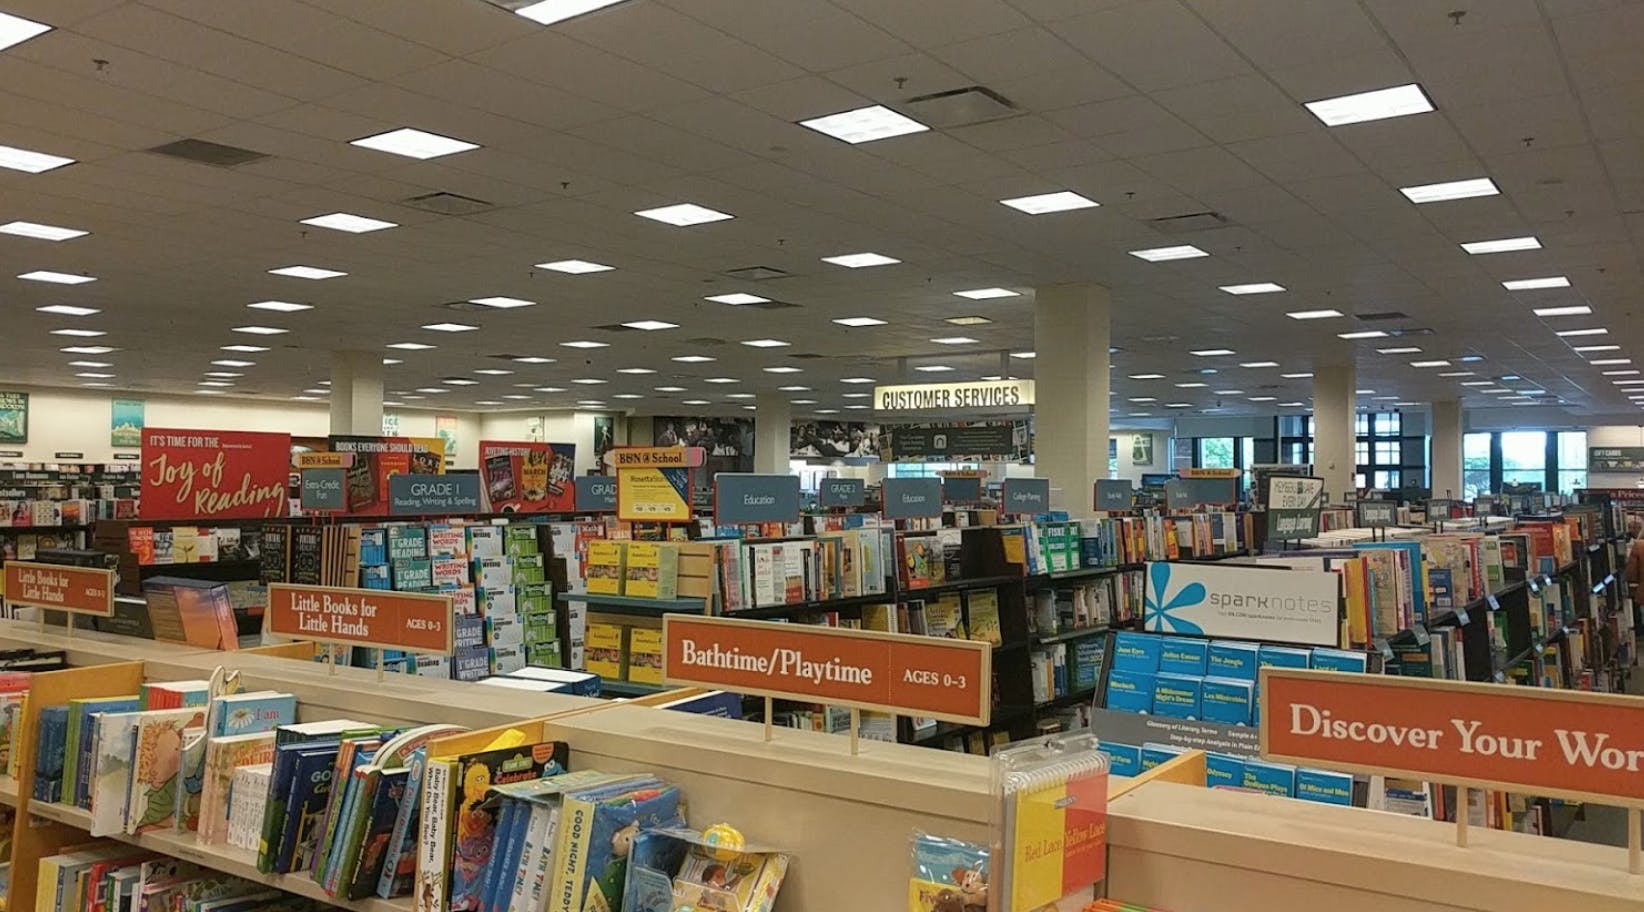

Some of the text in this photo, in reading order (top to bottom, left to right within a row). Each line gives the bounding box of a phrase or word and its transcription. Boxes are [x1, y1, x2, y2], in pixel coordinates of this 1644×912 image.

[883, 386, 1019, 410] CUSTOMER SERVICES
[150, 435, 165, 447] IT'S
[167, 436, 186, 447] TIME
[188, 436, 202, 448] FOR
[204, 437, 219, 448] THE
[335, 441, 357, 451] BOOKS
[390, 443, 412, 452] SHOULD
[652, 452, 682, 463] School
[150, 451, 226, 503] Joy of
[194, 472, 284, 518] Reading
[411, 484, 451, 495] GRADE
[394, 498, 420, 508] Reading,
[422, 496, 446, 507] Writing
[744, 494, 775, 505] Education
[398, 538, 423, 548] GRADE
[37, 570, 58, 588] Books
[404, 569, 428, 580] GRADE
[42, 586, 65, 602] Hands
[291, 592, 377, 618] Little Books for
[1210, 592, 1332, 613] sparknotes
[299, 612, 369, 637] Little Hands
[406, 618, 441, 632] AGES 0-3
[457, 627, 482, 638] GRADE
[455, 639, 483, 647] RITING
[465, 657, 488, 669] GRADE
[682, 640, 872, 685] Bathtime/Playtime
[903, 668, 939, 685] AGES
[256, 708, 279, 721] I am
[1146, 720, 1171, 730] Glossary
[1178, 724, 1200, 734] Literary
[1201, 727, 1218, 735] Terms
[1228, 730, 1249, 739] Sample
[1290, 703, 1644, 772] Discover Your Wor
[1206, 739, 1231, 748] Analysis
[1244, 772, 1256, 780] The
[1270, 784, 1288, 793] Plays
[1335, 789, 1349, 797] Men
[425, 791, 431, 803] Do
[428, 768, 441, 862] Baby Bear, Baby Bear,
[560, 809, 584, 912] GOOD NIGHT, TEDDY
